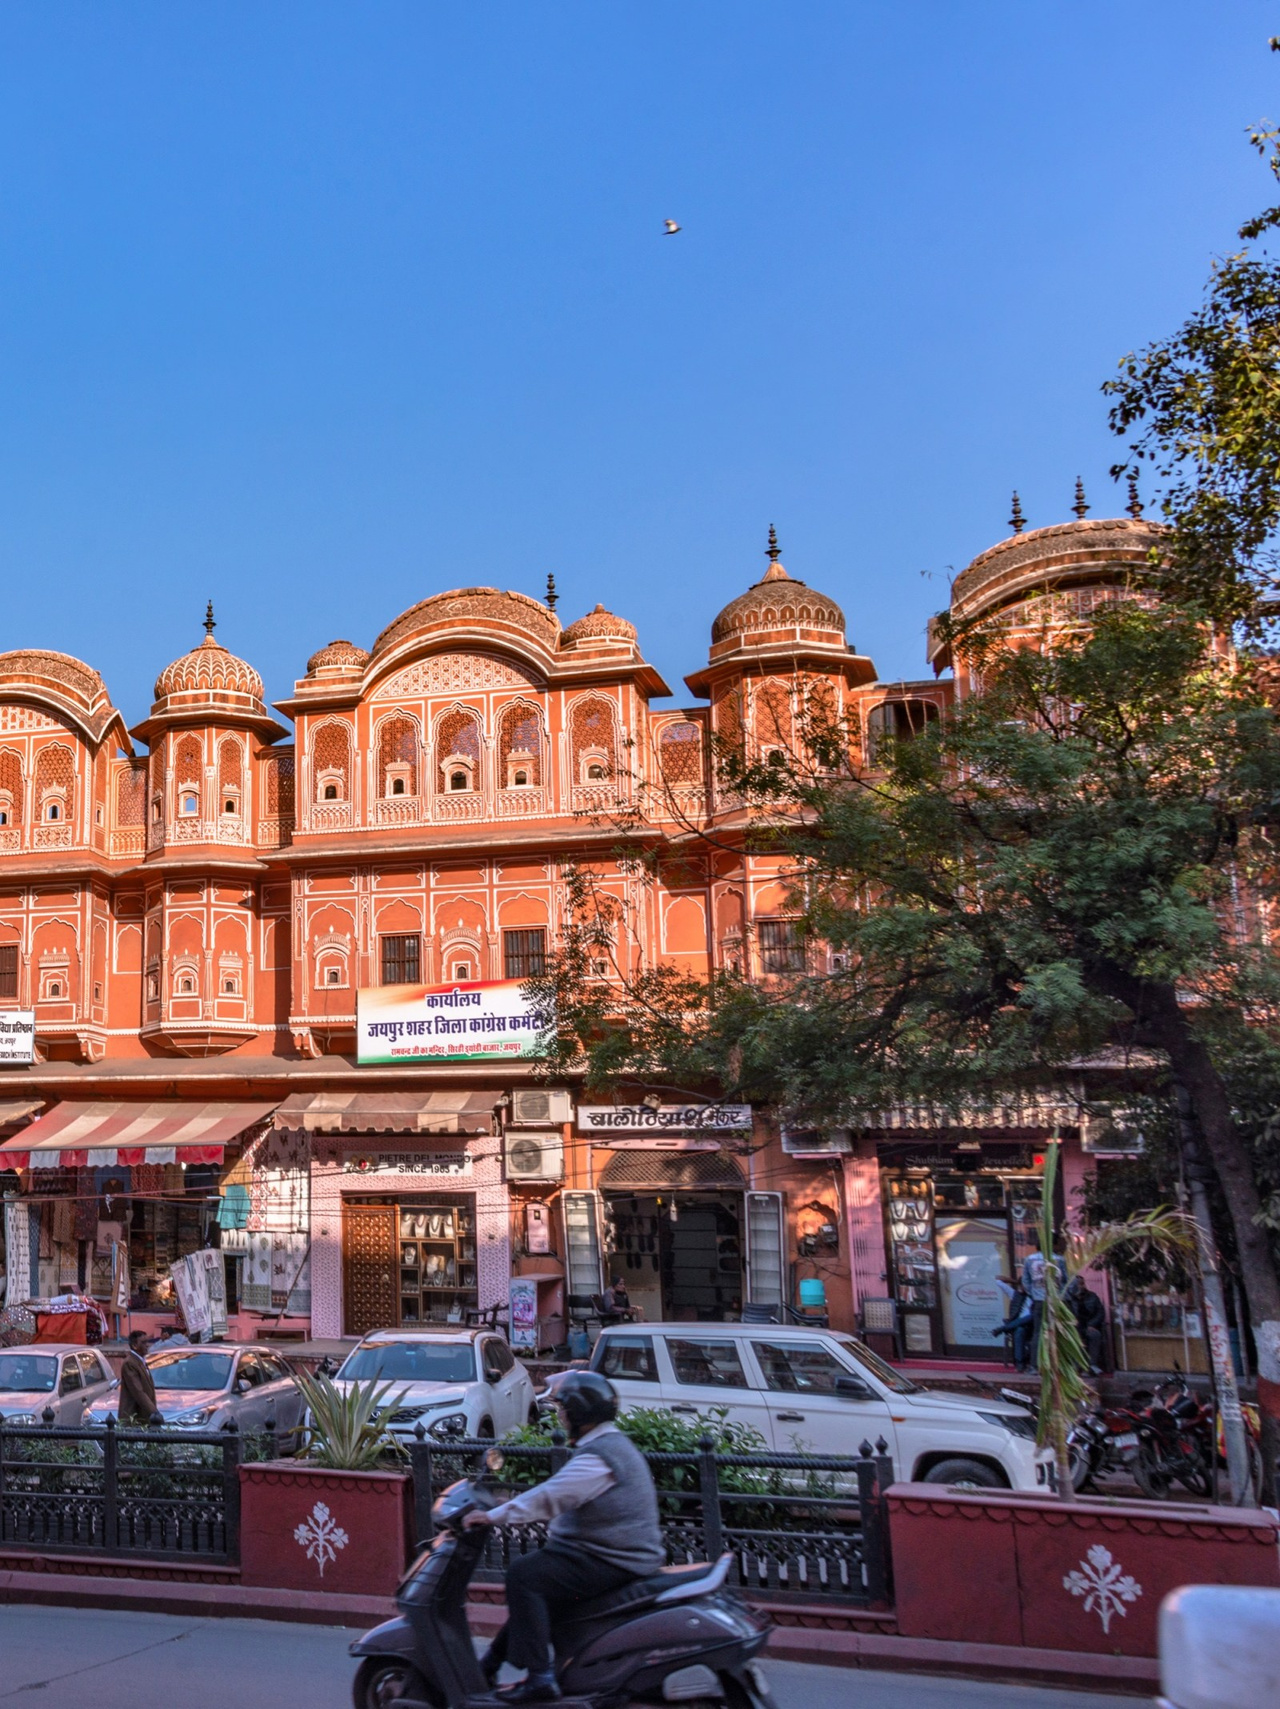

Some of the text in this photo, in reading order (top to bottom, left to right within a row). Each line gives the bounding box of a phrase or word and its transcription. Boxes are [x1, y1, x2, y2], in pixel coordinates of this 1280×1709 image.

[427, 990, 481, 1008] कार्यालय
[368, 1021, 404, 1042] जयपुर
[406, 1020, 432, 1036] शहर
[434, 1016, 467, 1034] जिला
[469, 1012, 506, 1033] कांग्रेस
[503, 1043, 521, 1053] जयपुर
[378, 1154, 413, 1163] PIETRE
[415, 1154, 430, 1162] DEL
[398, 1164, 426, 1174] SINCE
